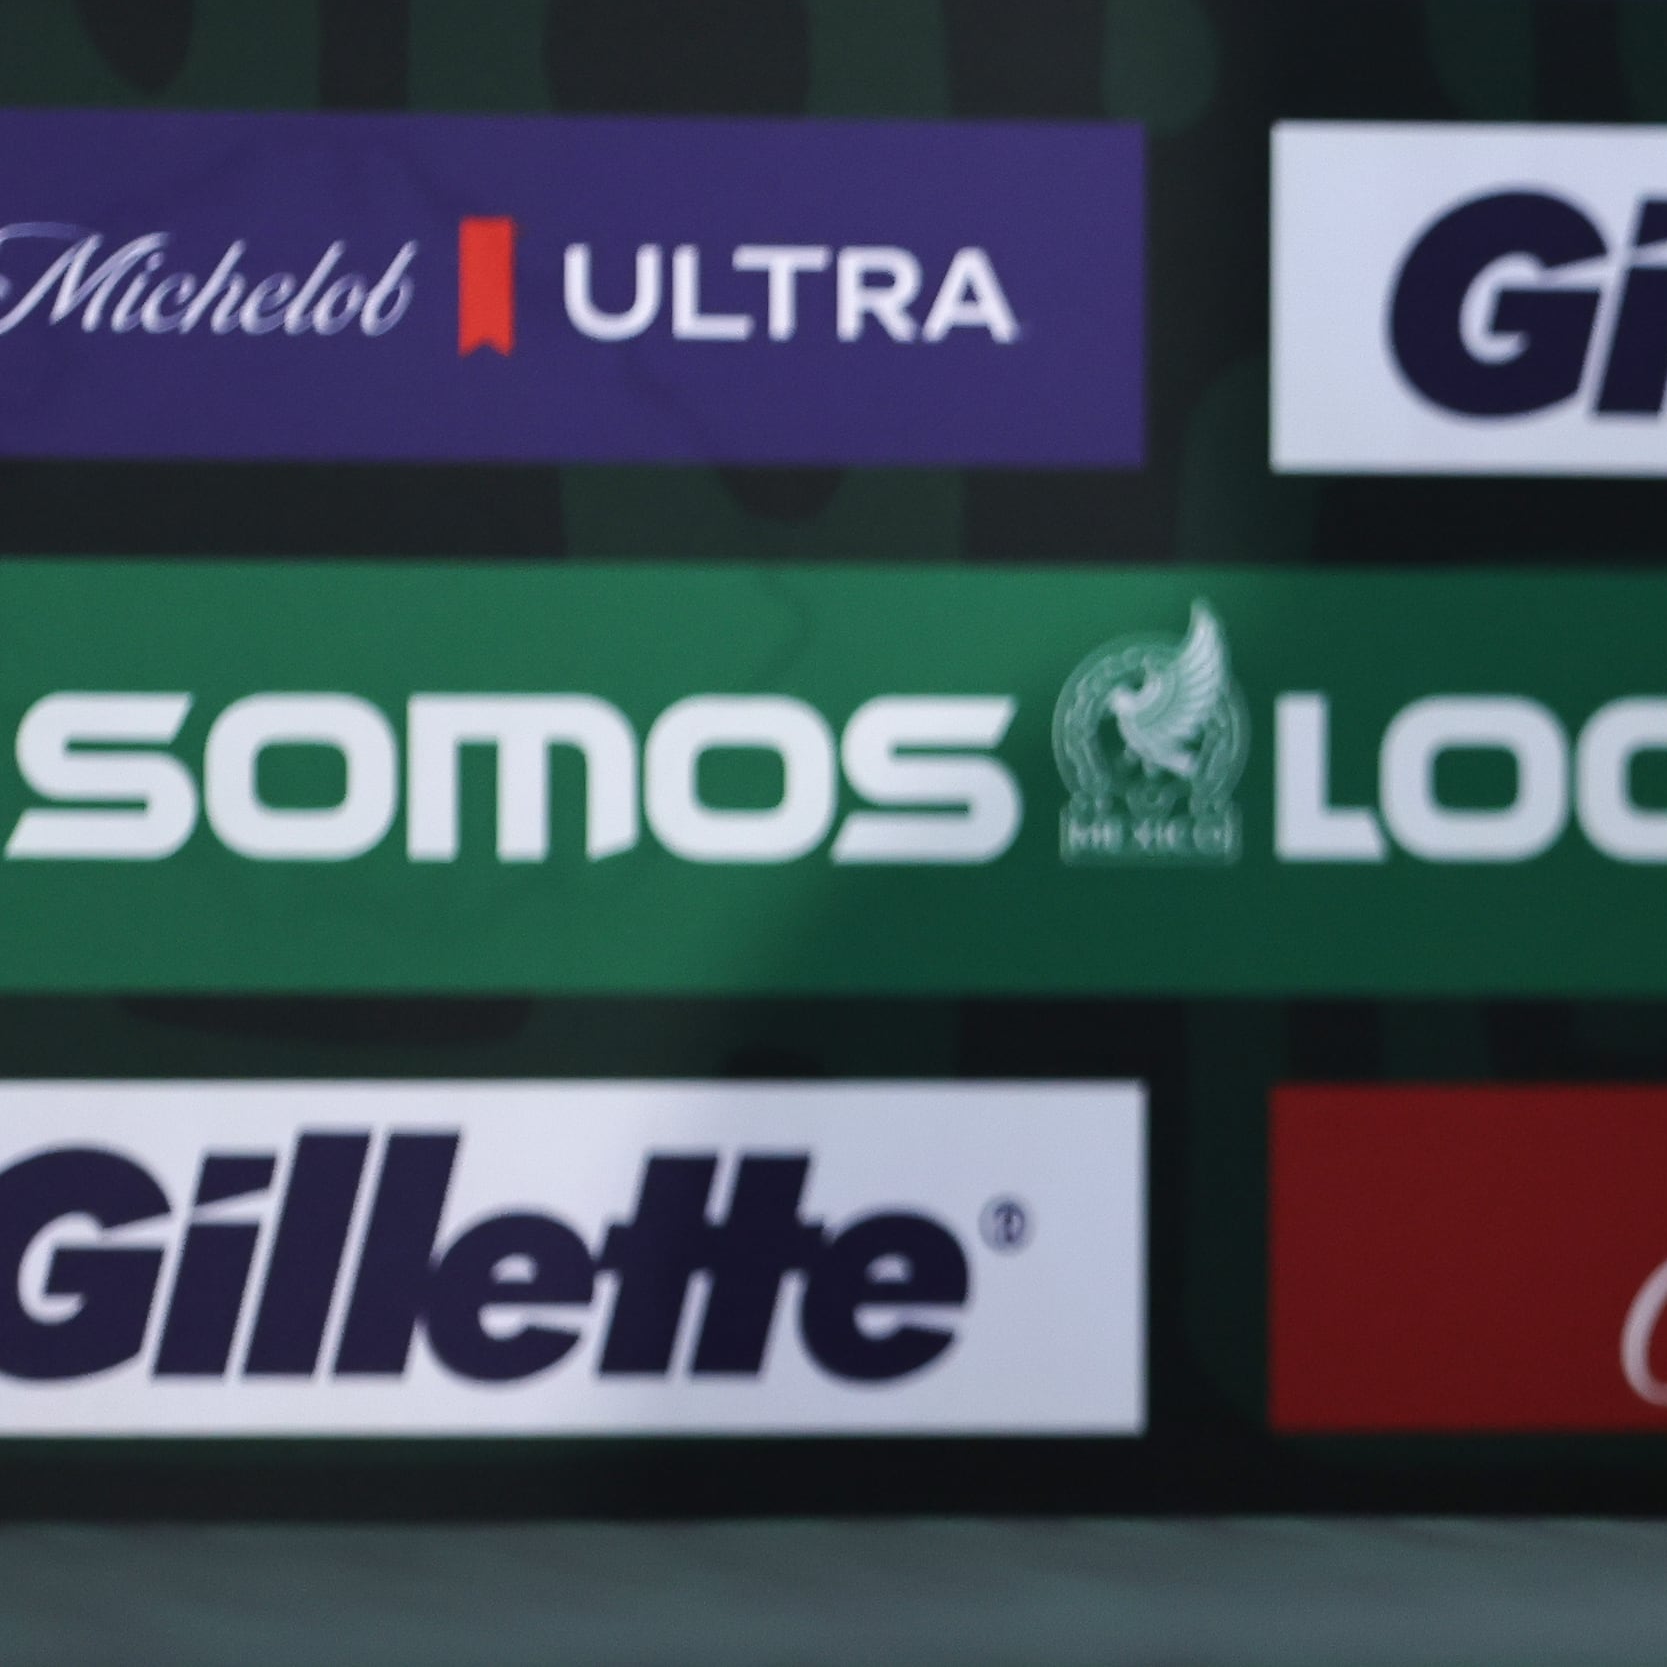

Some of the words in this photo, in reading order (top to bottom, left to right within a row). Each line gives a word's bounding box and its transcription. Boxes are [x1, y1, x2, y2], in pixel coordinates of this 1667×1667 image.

[0, 220, 419, 338] Michelob
[562, 243, 1019, 344] ULTRA
[3, 690, 1022, 865] SOMOS
[0, 1127, 972, 1391] Gillette
